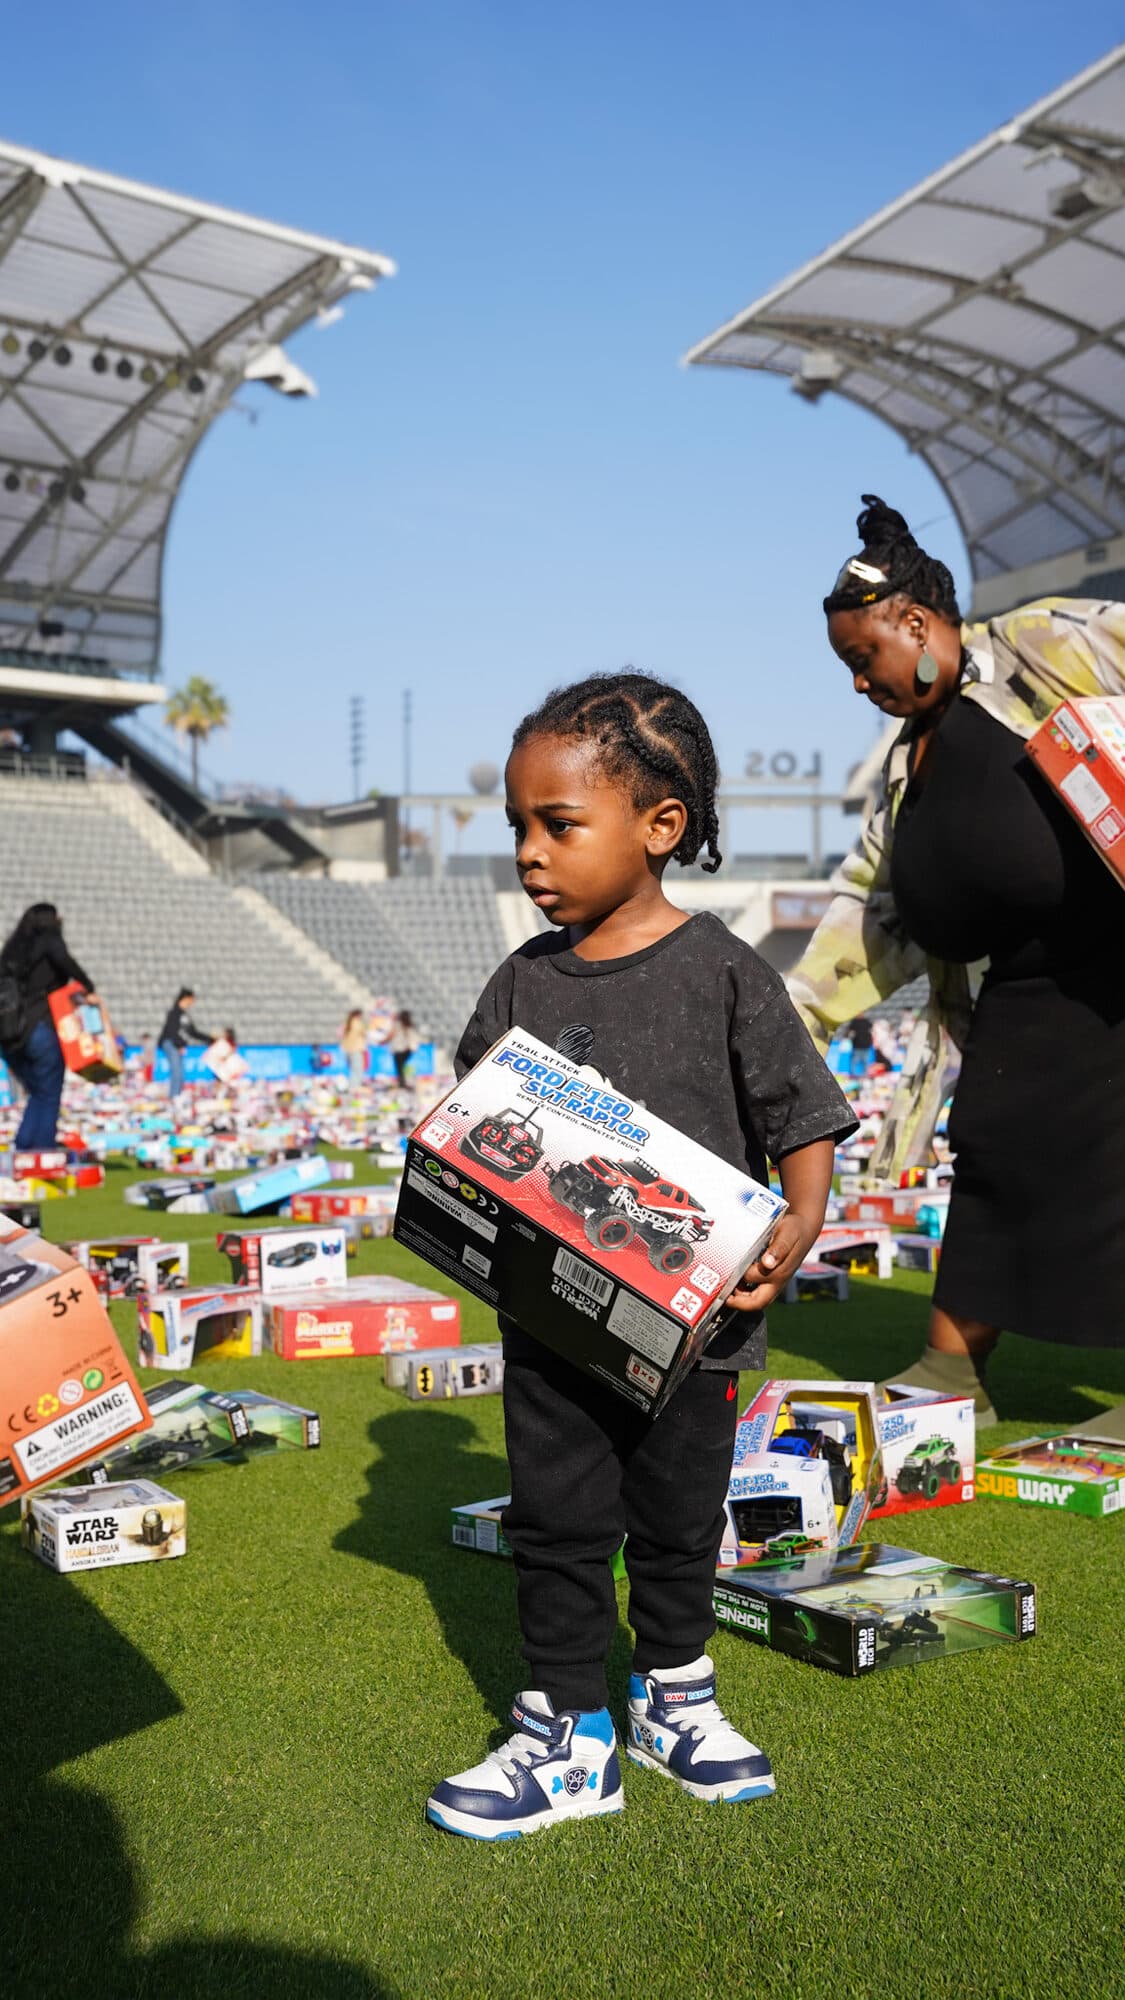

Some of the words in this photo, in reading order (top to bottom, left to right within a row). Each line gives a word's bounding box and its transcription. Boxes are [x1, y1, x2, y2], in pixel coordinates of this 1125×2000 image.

[511, 1040, 538, 1057] TRAIL
[541, 1055, 581, 1075] ATTACK
[495, 1049, 565, 1087] FORD
[562, 1079, 632, 1118] F-150
[447, 1103, 470, 1117] 6+
[525, 1080, 567, 1104] SVT
[565, 1099, 648, 1142] RAPTOR
[516, 1093, 544, 1108] REMOTE
[546, 1105, 579, 1123] CONTROL
[581, 1122, 615, 1141] MONSTER
[617, 1139, 640, 1152] TRUCK
[553, 1276, 575, 1295] TOYS
[696, 1268, 718, 1286] 1:24
[46, 1287, 83, 1317] 3+
[550, 1283, 598, 1321] WORLD
[578, 1293, 600, 1313] TECH
[54, 1393, 129, 1439] WARNING:
[976, 1473, 1075, 1505] SUBWAY
[66, 1517, 119, 1533] STAR
[807, 1520, 820, 1528] 6+
[66, 1528, 119, 1545] WARS
[713, 1600, 768, 1635] HORNE
[867, 1627, 875, 1645] TOYS
[858, 1628, 868, 1668] WORLD
[867, 1646, 875, 1667] TECH
[664, 1692, 686, 1702] PAW
[523, 1715, 551, 1736] PATROL
